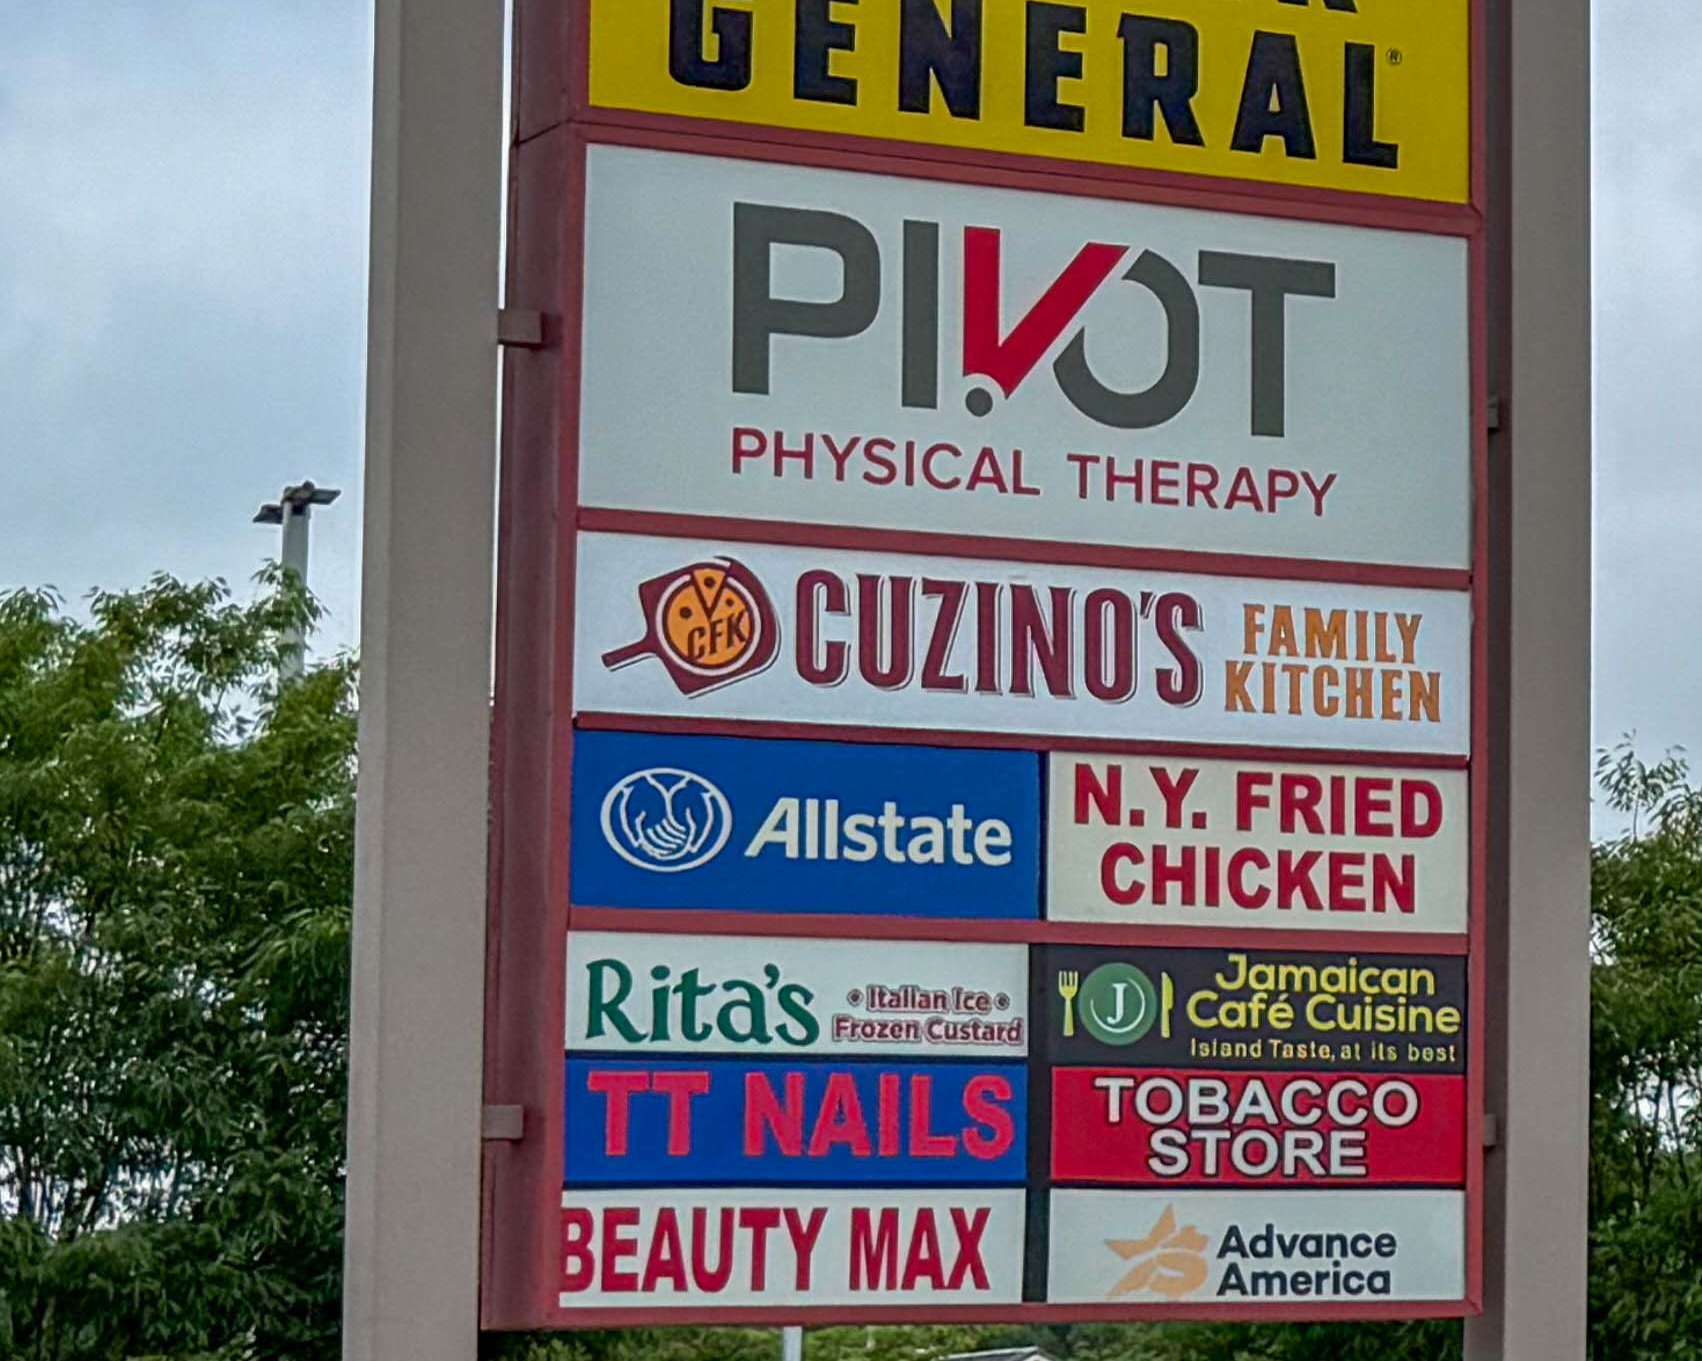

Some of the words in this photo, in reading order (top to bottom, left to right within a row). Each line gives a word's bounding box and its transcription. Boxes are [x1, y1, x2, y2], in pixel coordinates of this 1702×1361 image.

[731, 201, 1337, 438] PIVOT
[730, 425, 1042, 498] PHYSICAL
[1067, 453, 1338, 518] THERAPY
[794, 568, 1205, 709] CUZINO'S
[1241, 603, 1425, 666] FAMILY
[1223, 662, 1441, 725] KITCHEN
[744, 796, 1014, 867] Allstate
[1073, 762, 1208, 831] N.Y.
[1235, 771, 1444, 839] FRIED
[1099, 842, 1416, 914] CHICKEN
[585, 958, 820, 1048] Rita's
[866, 984, 949, 1012] Italian
[951, 986, 991, 1014] Ice
[1215, 953, 1435, 996] Jamaican
[832, 1014, 922, 1042] Frozen
[925, 1016, 1024, 1046] Custard
[1186, 990, 1295, 1029] Café
[1305, 994, 1462, 1034] Cuisine
[1190, 1038, 1262, 1059] Island
[1340, 1043, 1361, 1061] at
[1371, 1041, 1397, 1062] its
[1408, 1043, 1457, 1063] best
[588, 1070, 709, 1158] TT
[744, 1071, 1016, 1160] NAILS
[1094, 1076, 1420, 1128] TOBACCO
[1147, 1126, 1368, 1178] STORE
[560, 1207, 828, 1292] BEAUTY
[850, 1206, 992, 1291] MAX
[1216, 1223, 1397, 1259] Advance
[1216, 1262, 1391, 1297] America
